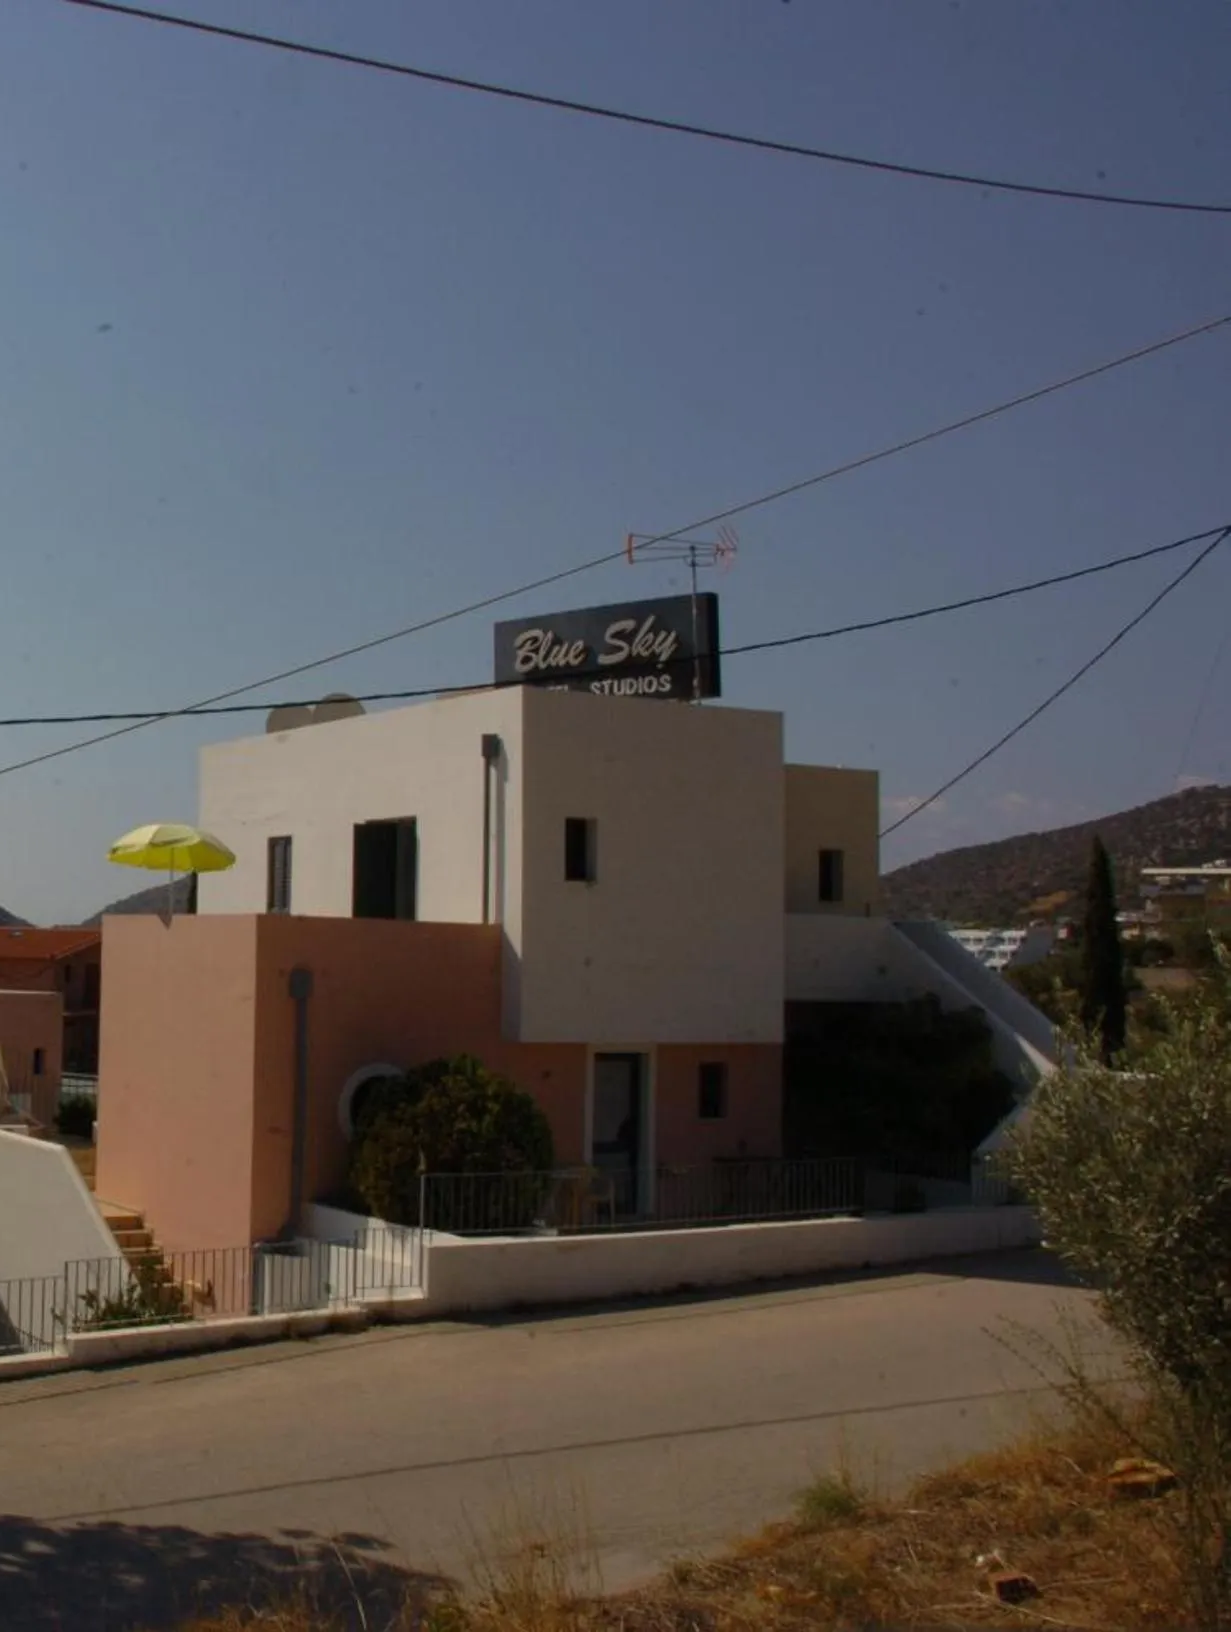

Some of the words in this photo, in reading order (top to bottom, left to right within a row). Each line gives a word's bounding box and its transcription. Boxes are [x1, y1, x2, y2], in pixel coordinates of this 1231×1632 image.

[514, 628, 586, 673] Blue
[597, 614, 680, 668] Sky
[590, 674, 672, 696] STUDIOS
